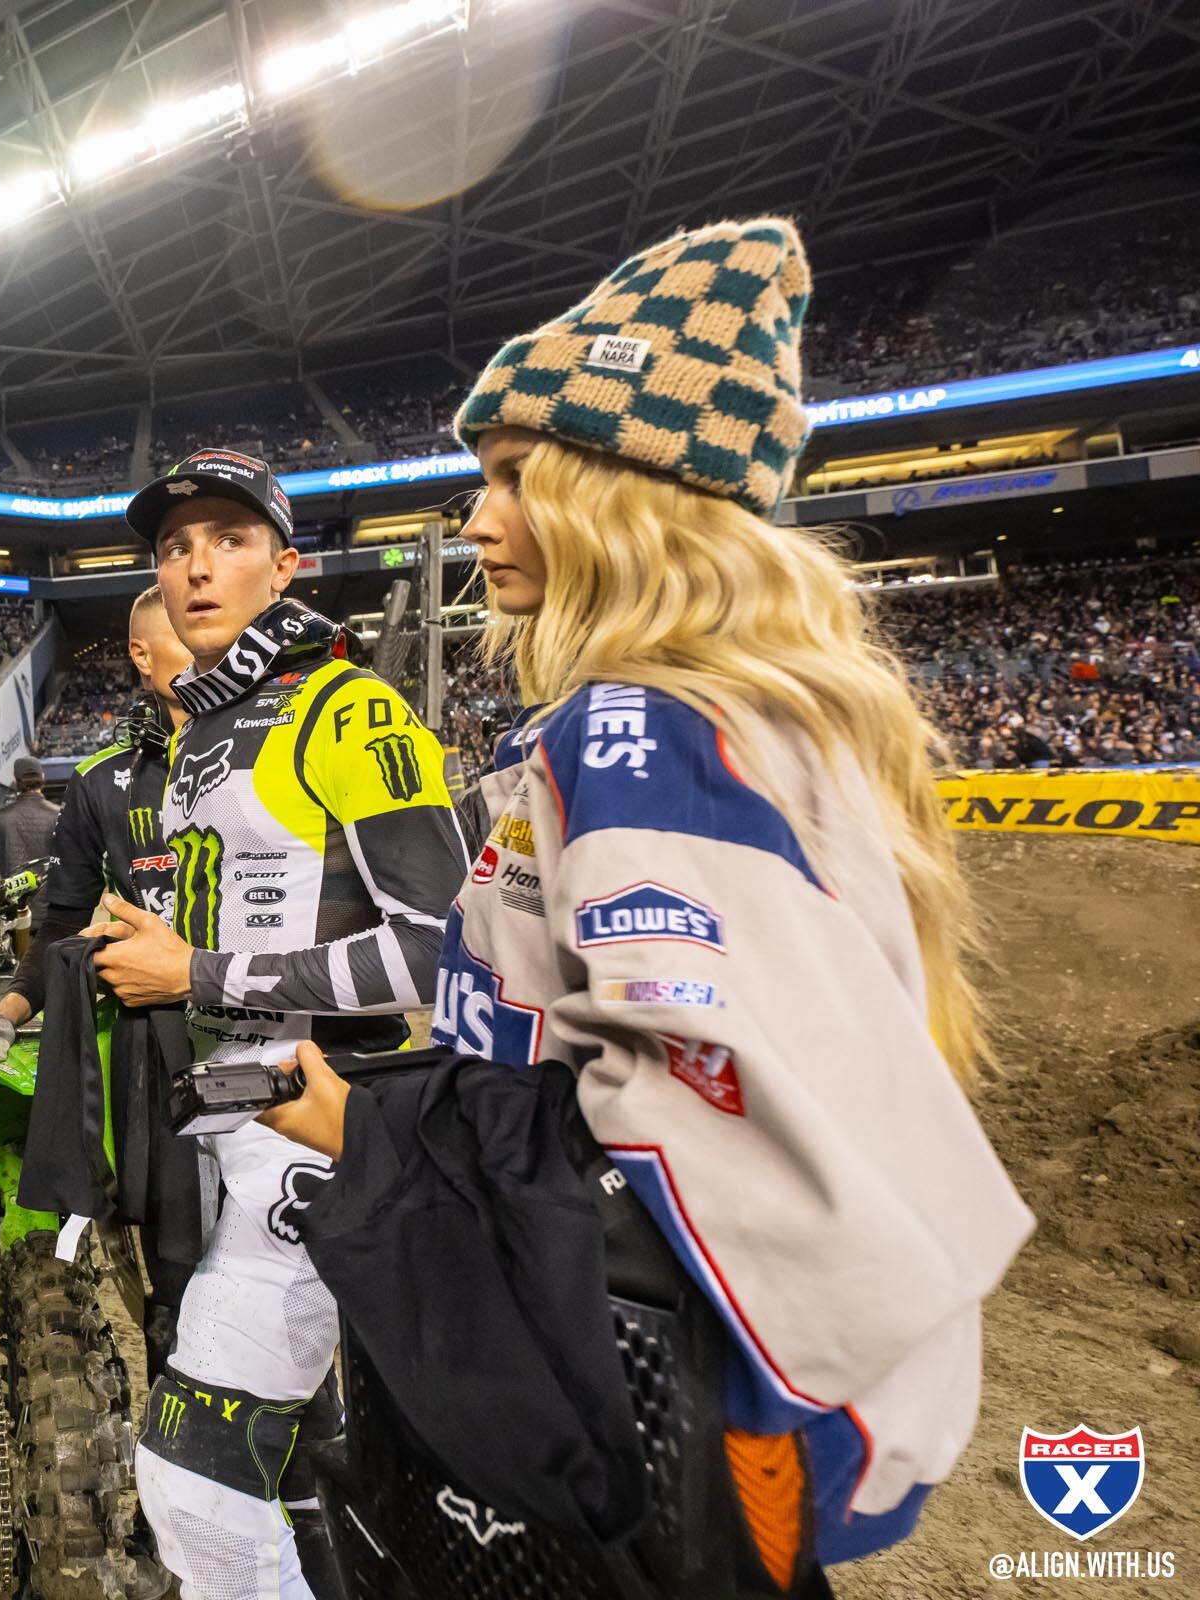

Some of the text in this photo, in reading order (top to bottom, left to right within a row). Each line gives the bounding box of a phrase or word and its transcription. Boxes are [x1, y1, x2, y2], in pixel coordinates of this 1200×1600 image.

[897, 388, 947, 411] LAP
[197, 462, 255, 480] Kawasaki
[233, 711, 295, 729] Kawasaki
[244, 871, 288, 879] SCOTT
[248, 891, 280, 900] BELL
[592, 906, 710, 938] LOWE'S
[626, 981, 714, 1005] NASCAR
[190, 1021, 275, 1047] CIRCUIT
